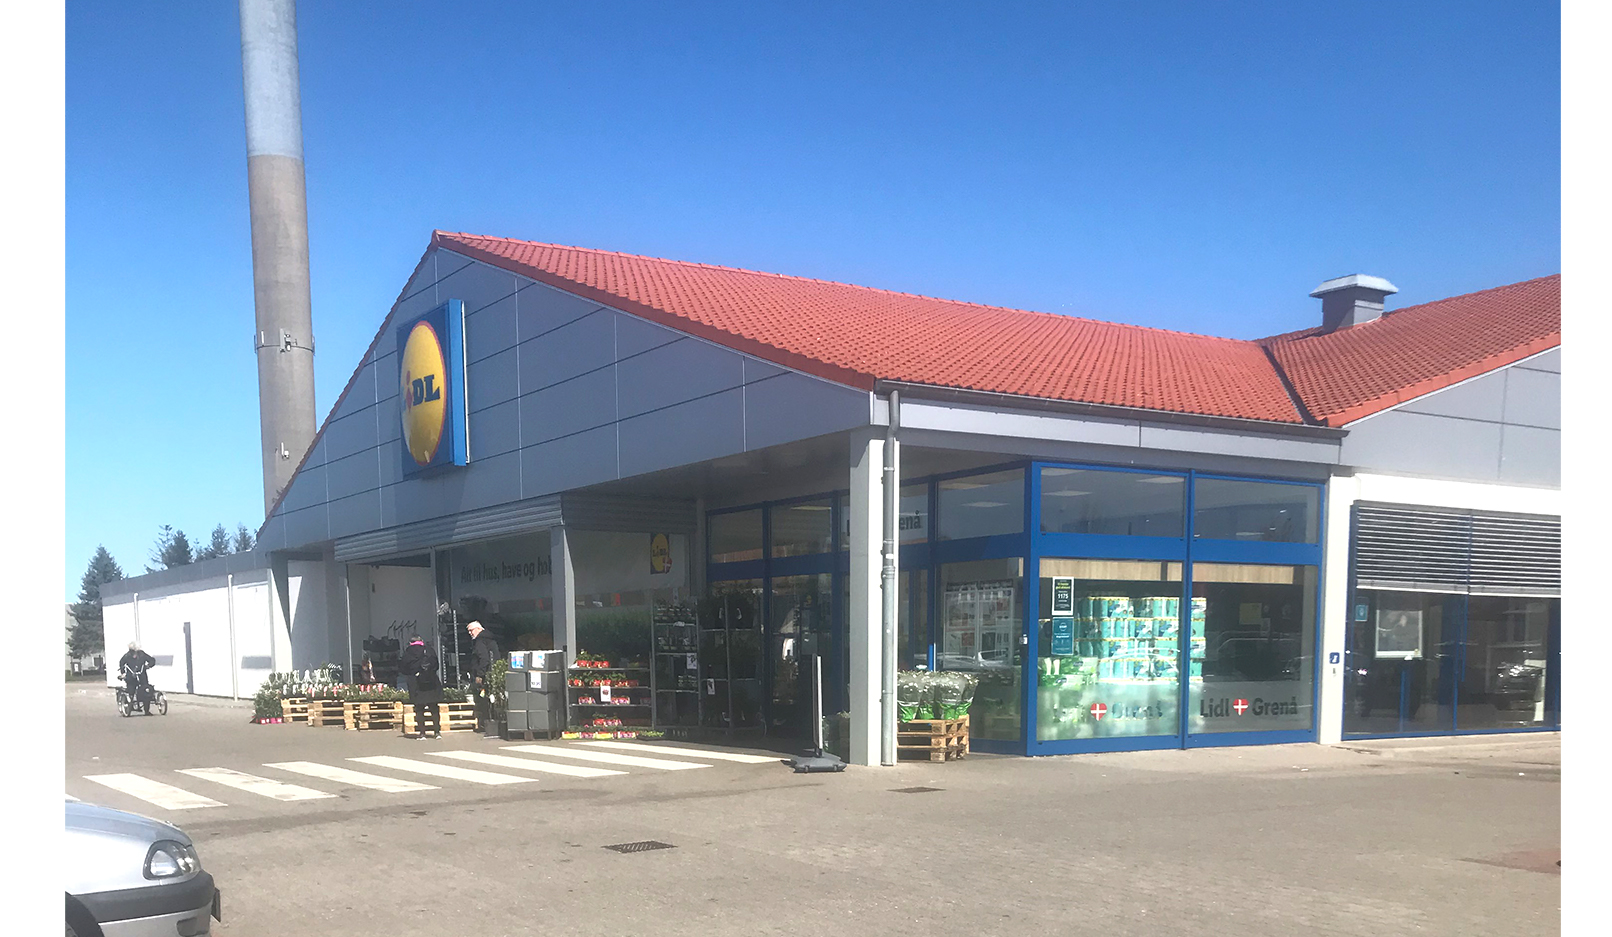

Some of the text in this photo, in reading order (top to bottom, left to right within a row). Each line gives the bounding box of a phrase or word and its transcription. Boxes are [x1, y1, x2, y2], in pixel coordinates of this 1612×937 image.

[899, 509, 922, 530] enå
[502, 561, 522, 579] have
[523, 562, 534, 581] og
[1200, 696, 1298, 717] Lidl Grenå
